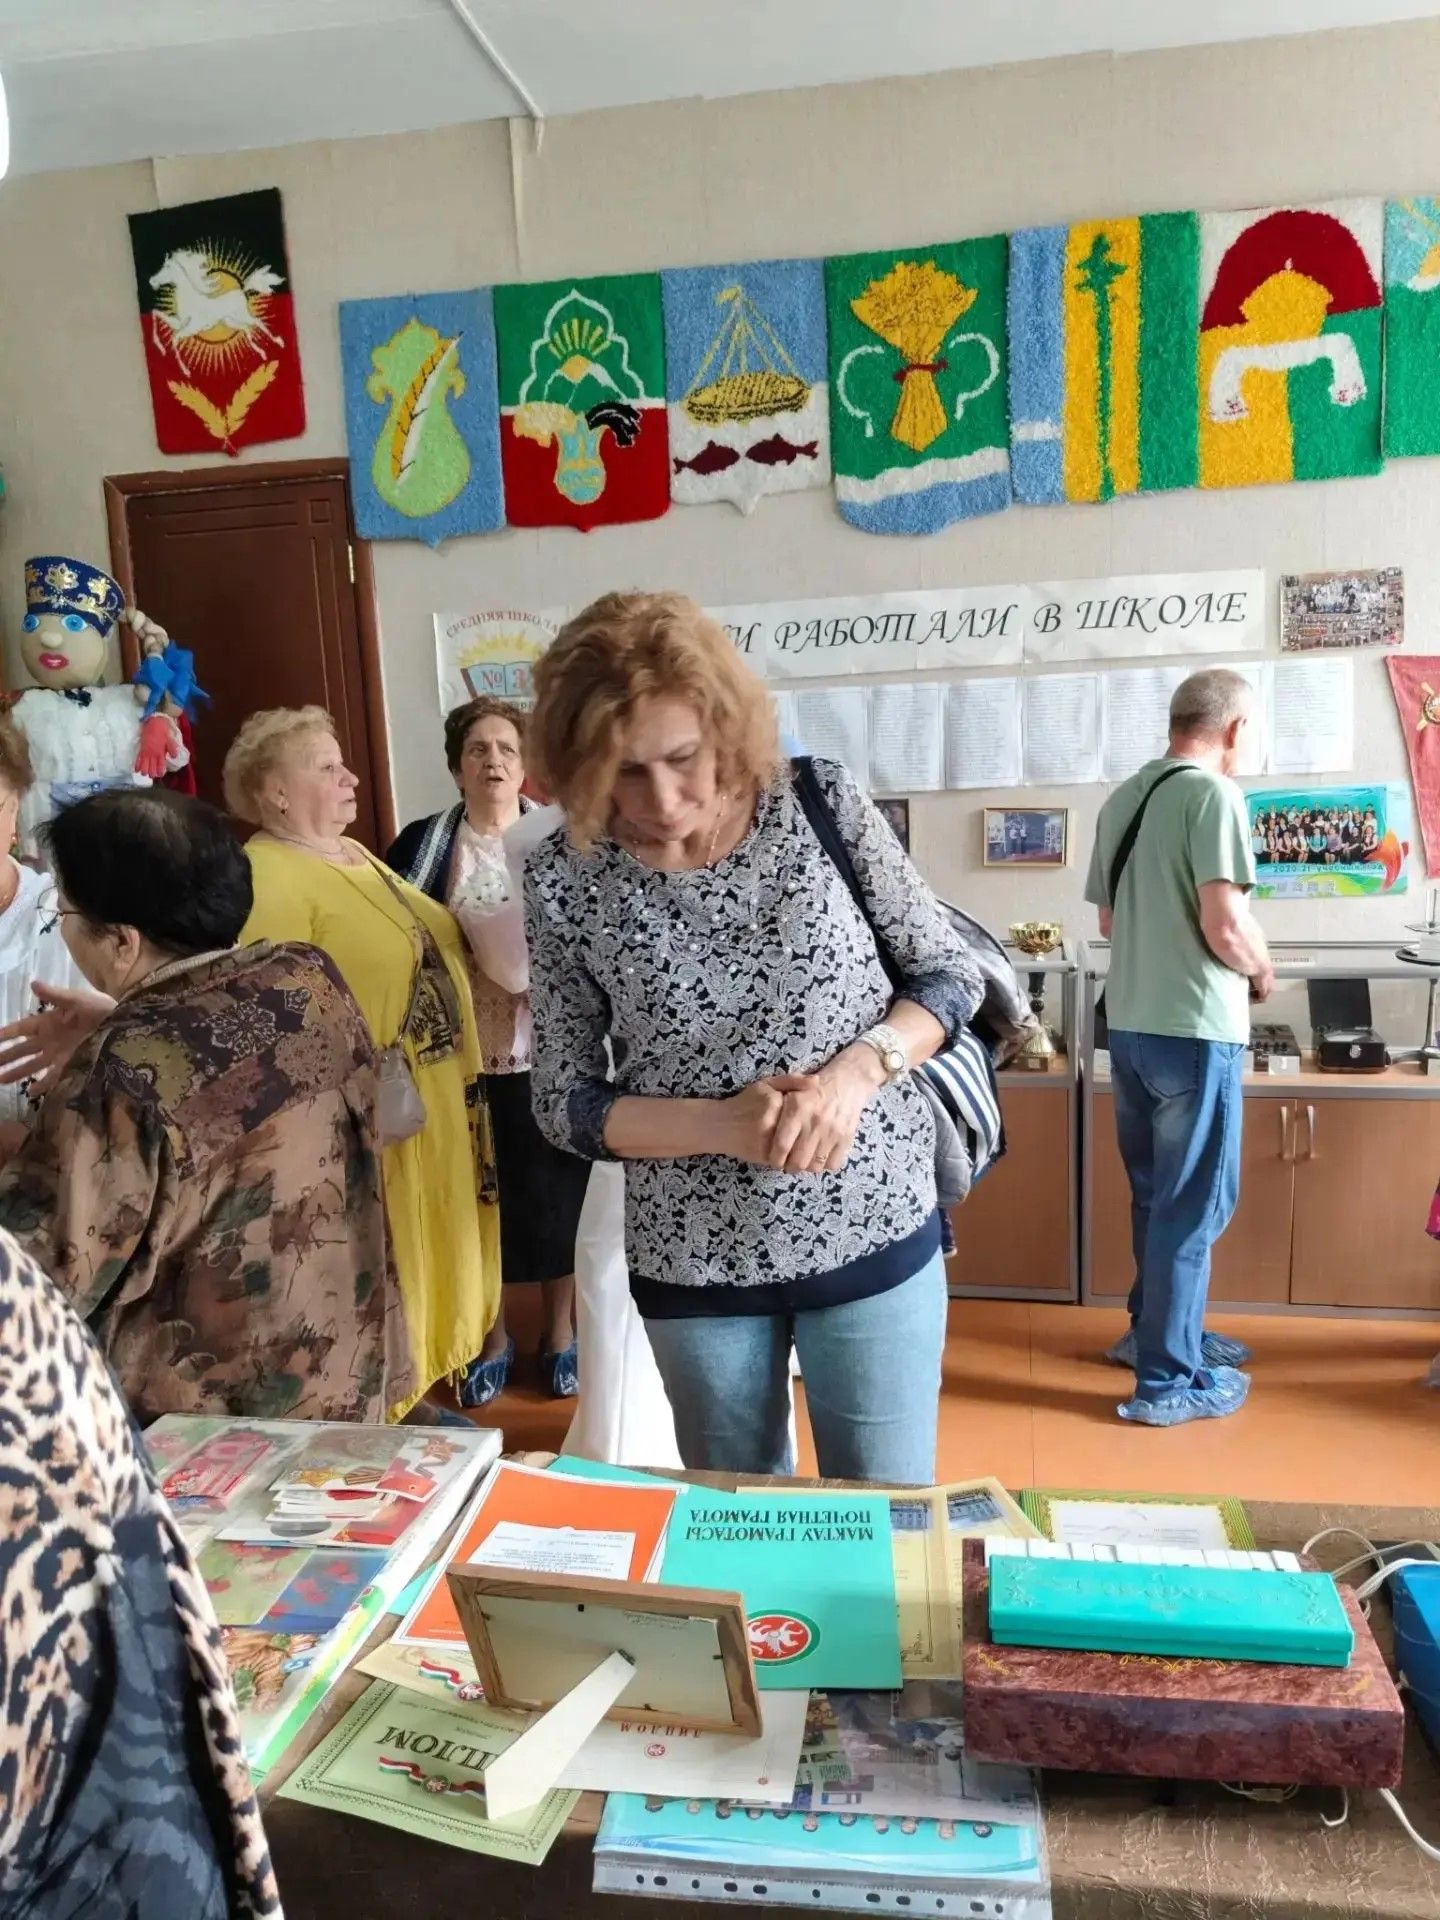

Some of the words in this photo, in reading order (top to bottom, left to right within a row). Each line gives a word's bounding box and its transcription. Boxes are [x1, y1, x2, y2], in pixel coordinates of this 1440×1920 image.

[446, 610, 504, 639] СРЕДНЯЯ
[774, 604, 1018, 653] РАБОТАЛИ
[1033, 603, 1062, 634] В
[1075, 591, 1248, 634] ШКОЛЕ
[690, 1509, 770, 1524] ГРАМОТА
[777, 1509, 872, 1524] ПОЧЕТНАЯ
[685, 1527, 796, 1541] ГРАМОТАСЫ
[802, 1527, 874, 1541] МАКТАУ
